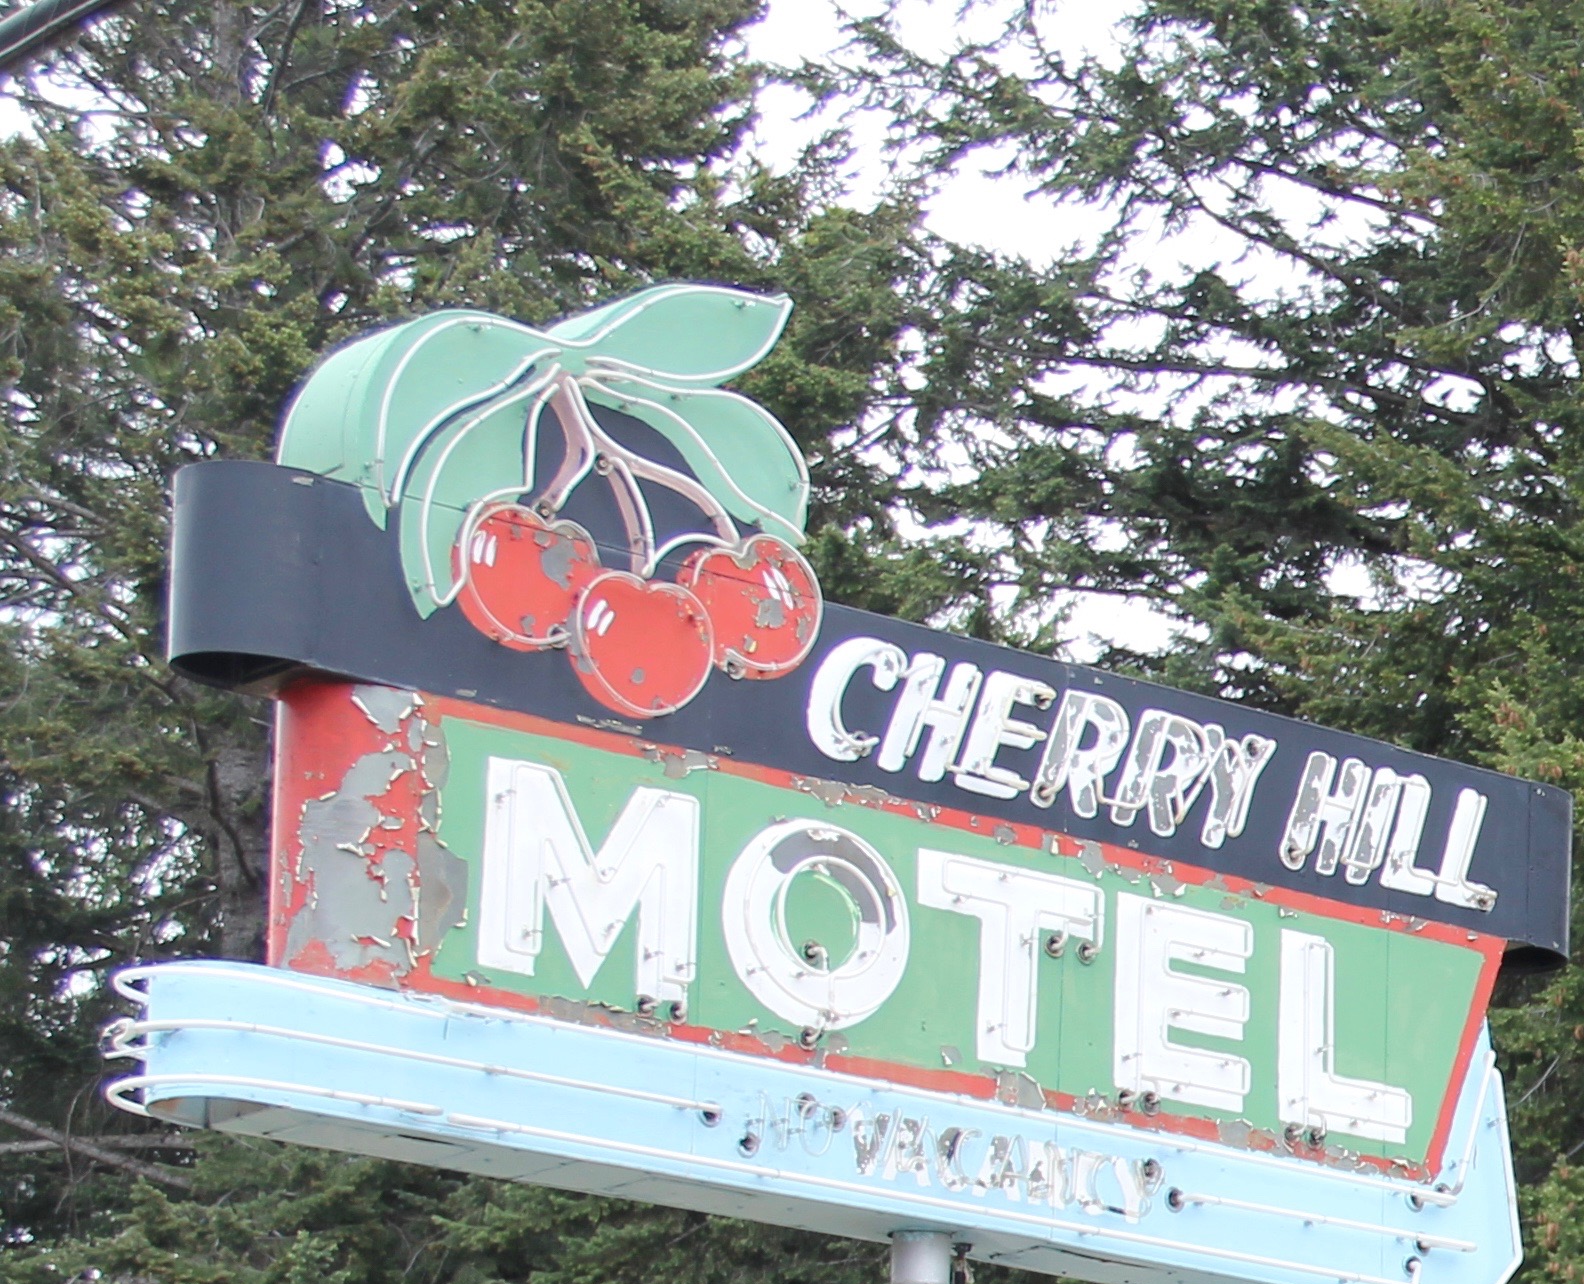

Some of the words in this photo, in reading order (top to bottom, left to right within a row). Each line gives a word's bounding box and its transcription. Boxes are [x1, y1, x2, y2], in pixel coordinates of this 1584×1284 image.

[806, 636, 1277, 849] CHERRY
[1278, 750, 1498, 913] HILL
[476, 756, 1412, 1146] MOTEL
[848, 1107, 1160, 1225] VACANCY
